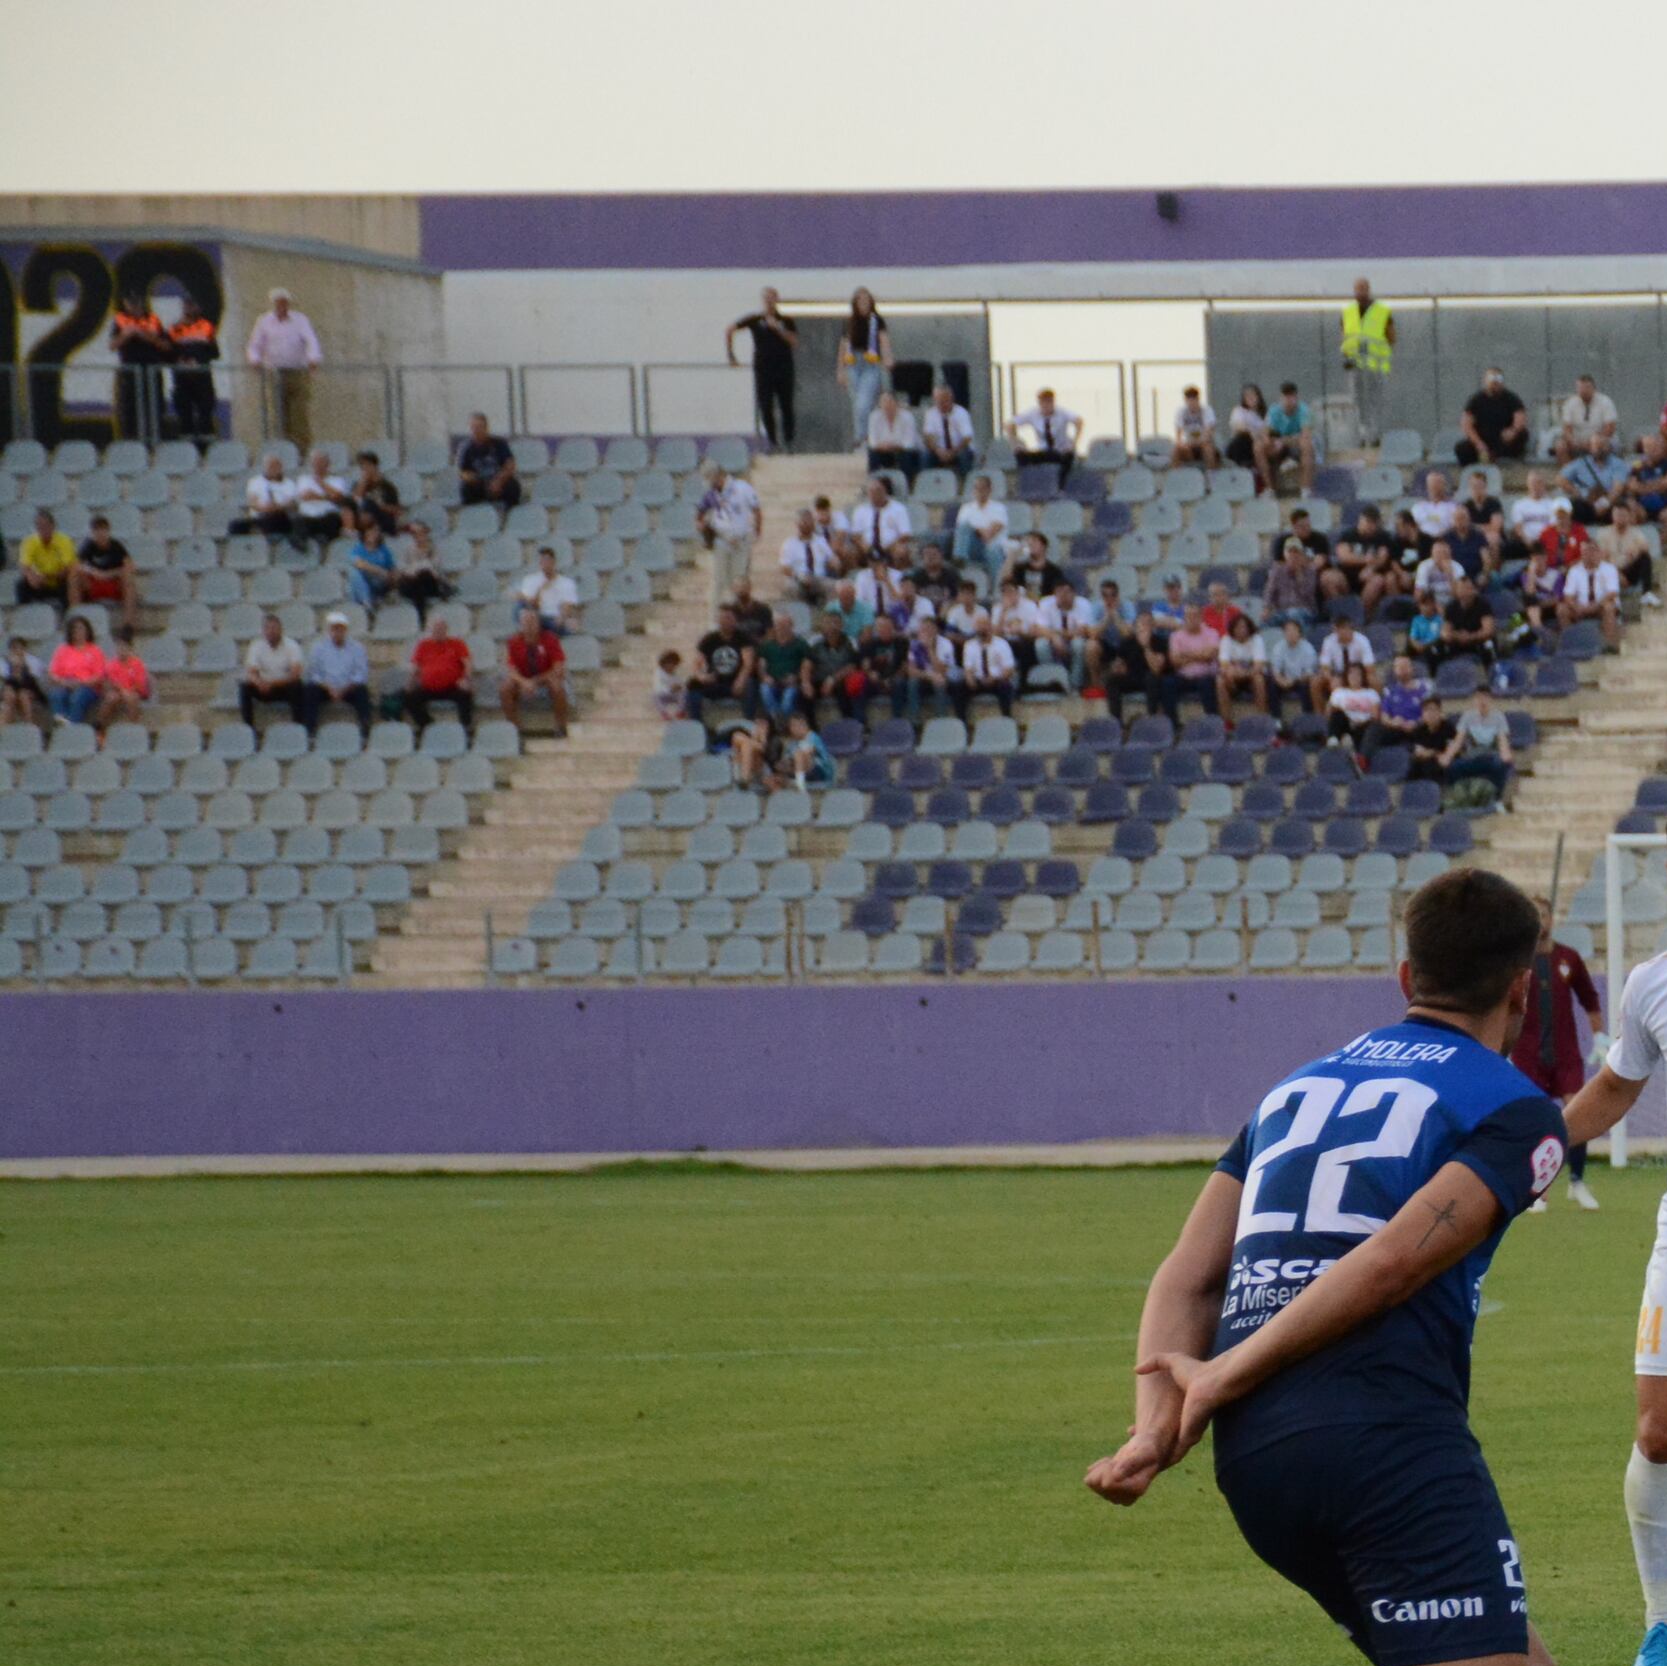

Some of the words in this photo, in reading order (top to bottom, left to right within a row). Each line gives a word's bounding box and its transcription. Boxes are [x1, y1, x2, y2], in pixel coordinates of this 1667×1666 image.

[1350, 1038, 1458, 1063] MOLERA
[1234, 1076, 1439, 1246] 22
[1371, 1596, 1485, 1623] Canon
